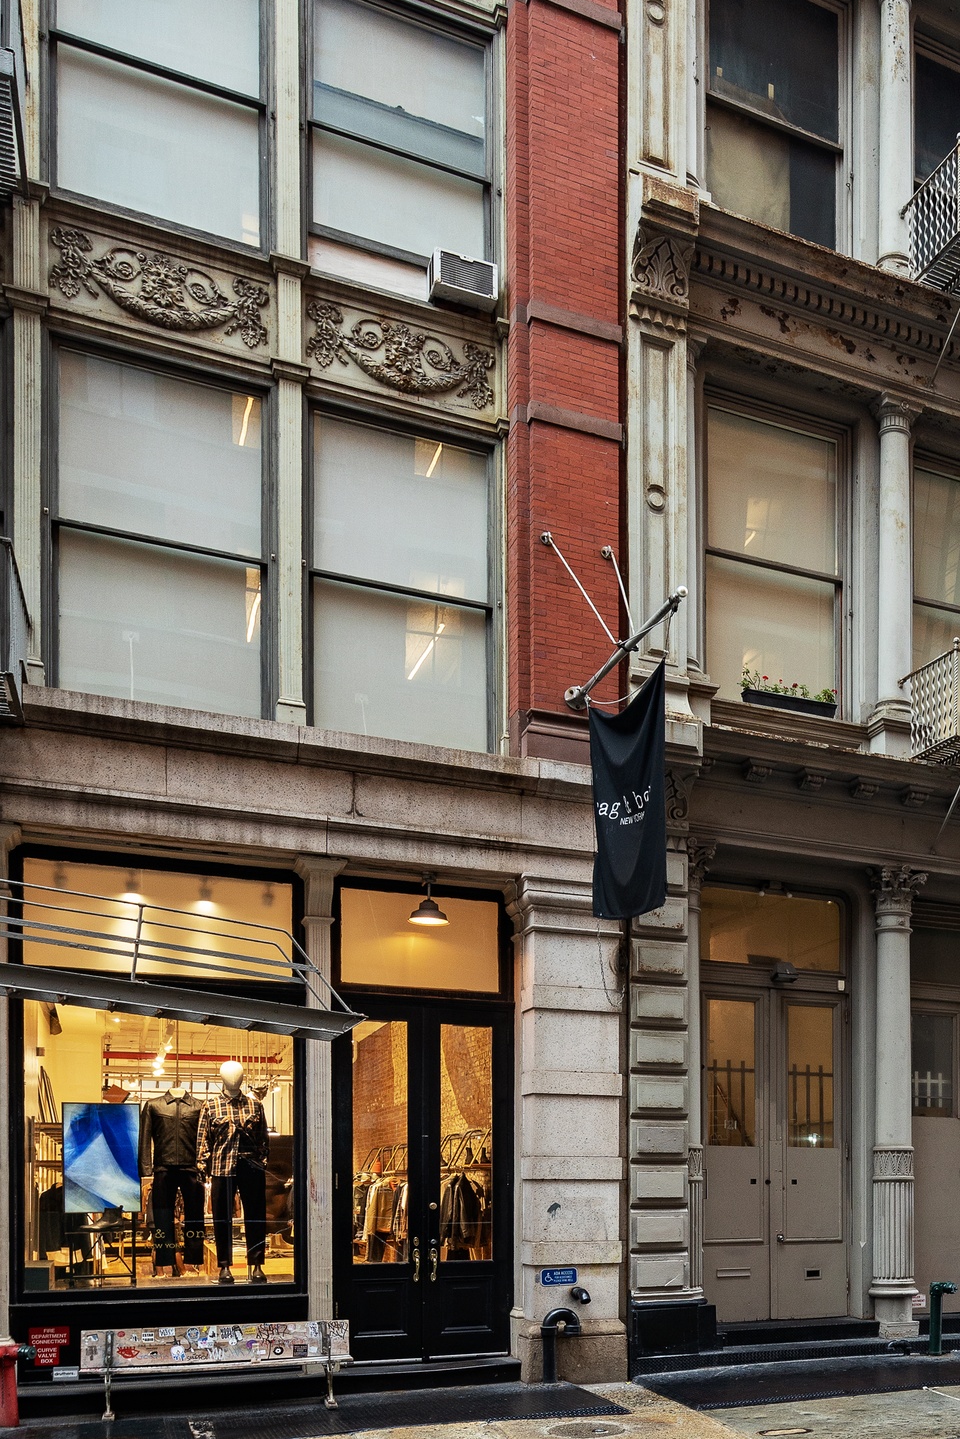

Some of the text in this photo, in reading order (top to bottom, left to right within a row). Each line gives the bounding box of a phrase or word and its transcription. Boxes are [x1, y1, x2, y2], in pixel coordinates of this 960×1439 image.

[596, 802, 621, 820] ag
[620, 816, 633, 826] NEW
[155, 1229, 166, 1239] &
